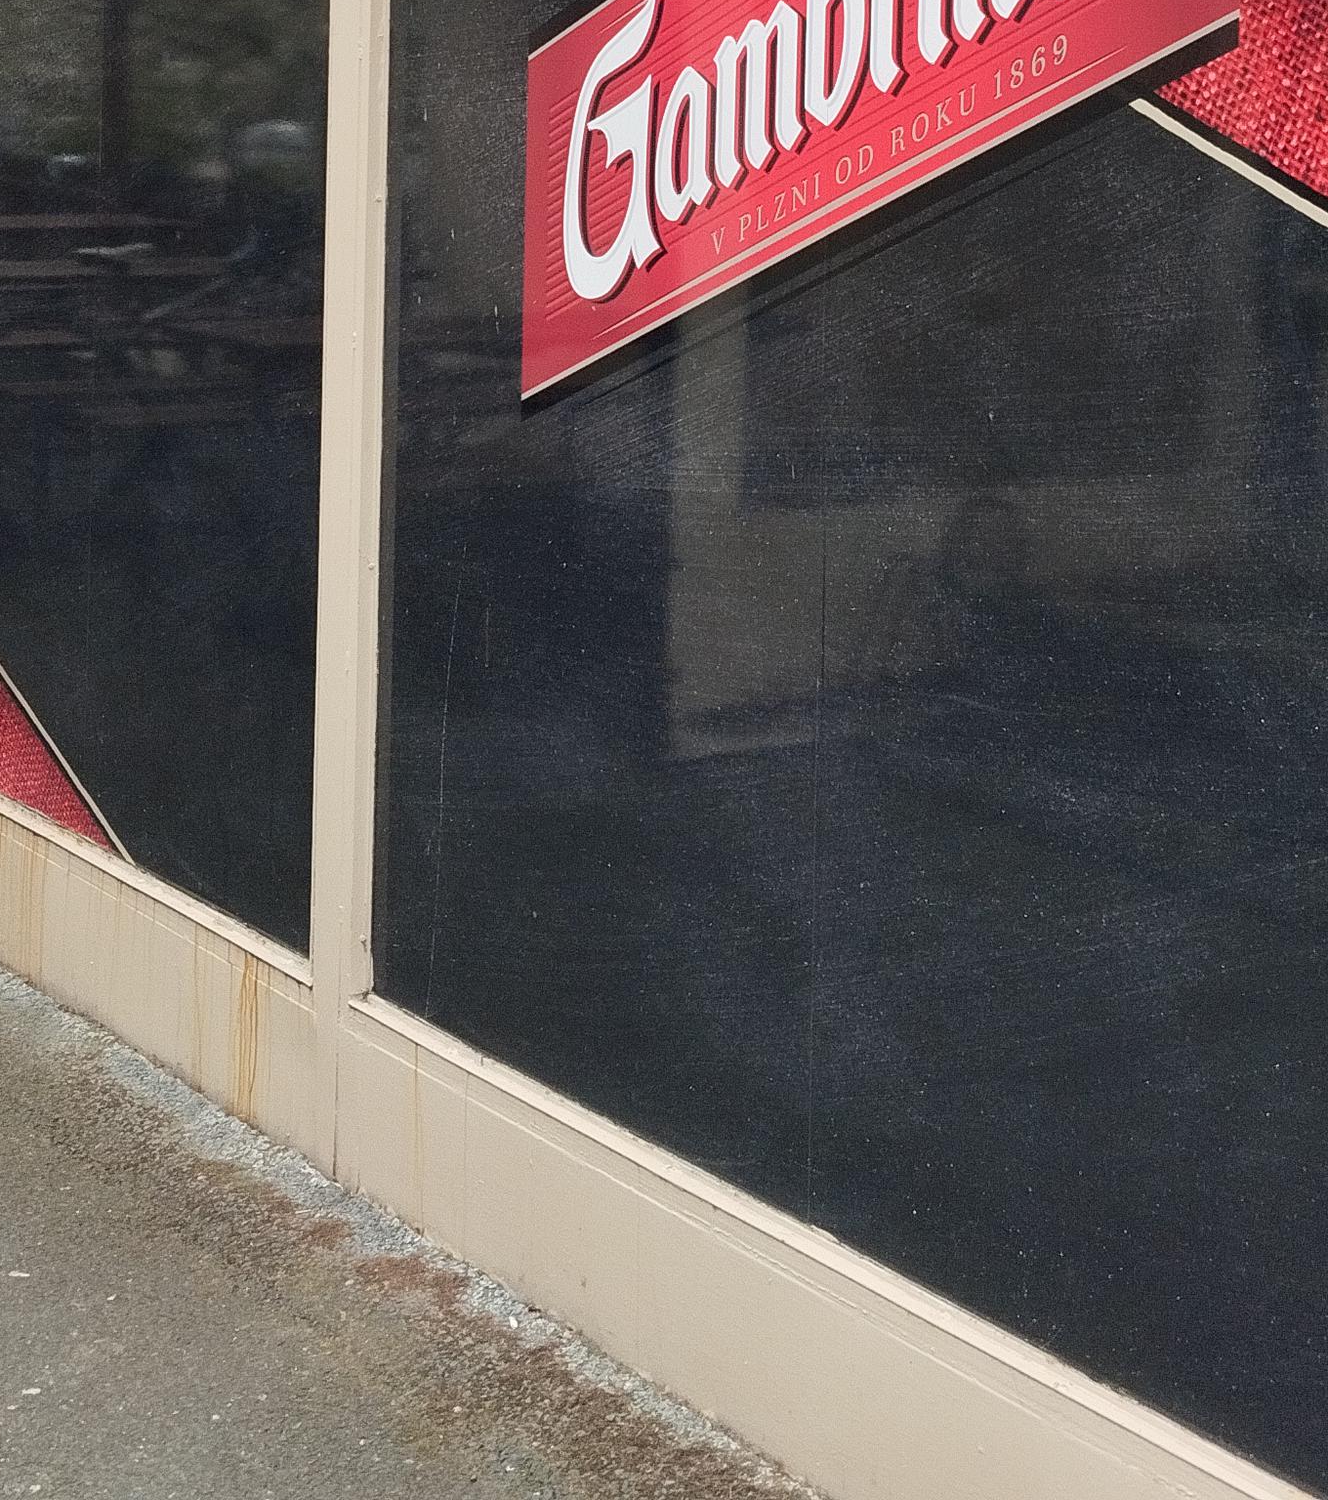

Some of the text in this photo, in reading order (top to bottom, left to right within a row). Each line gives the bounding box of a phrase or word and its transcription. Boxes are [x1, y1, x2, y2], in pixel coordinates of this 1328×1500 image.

[710, 33, 1070, 255] V PLZNI OD ROKU 1869
